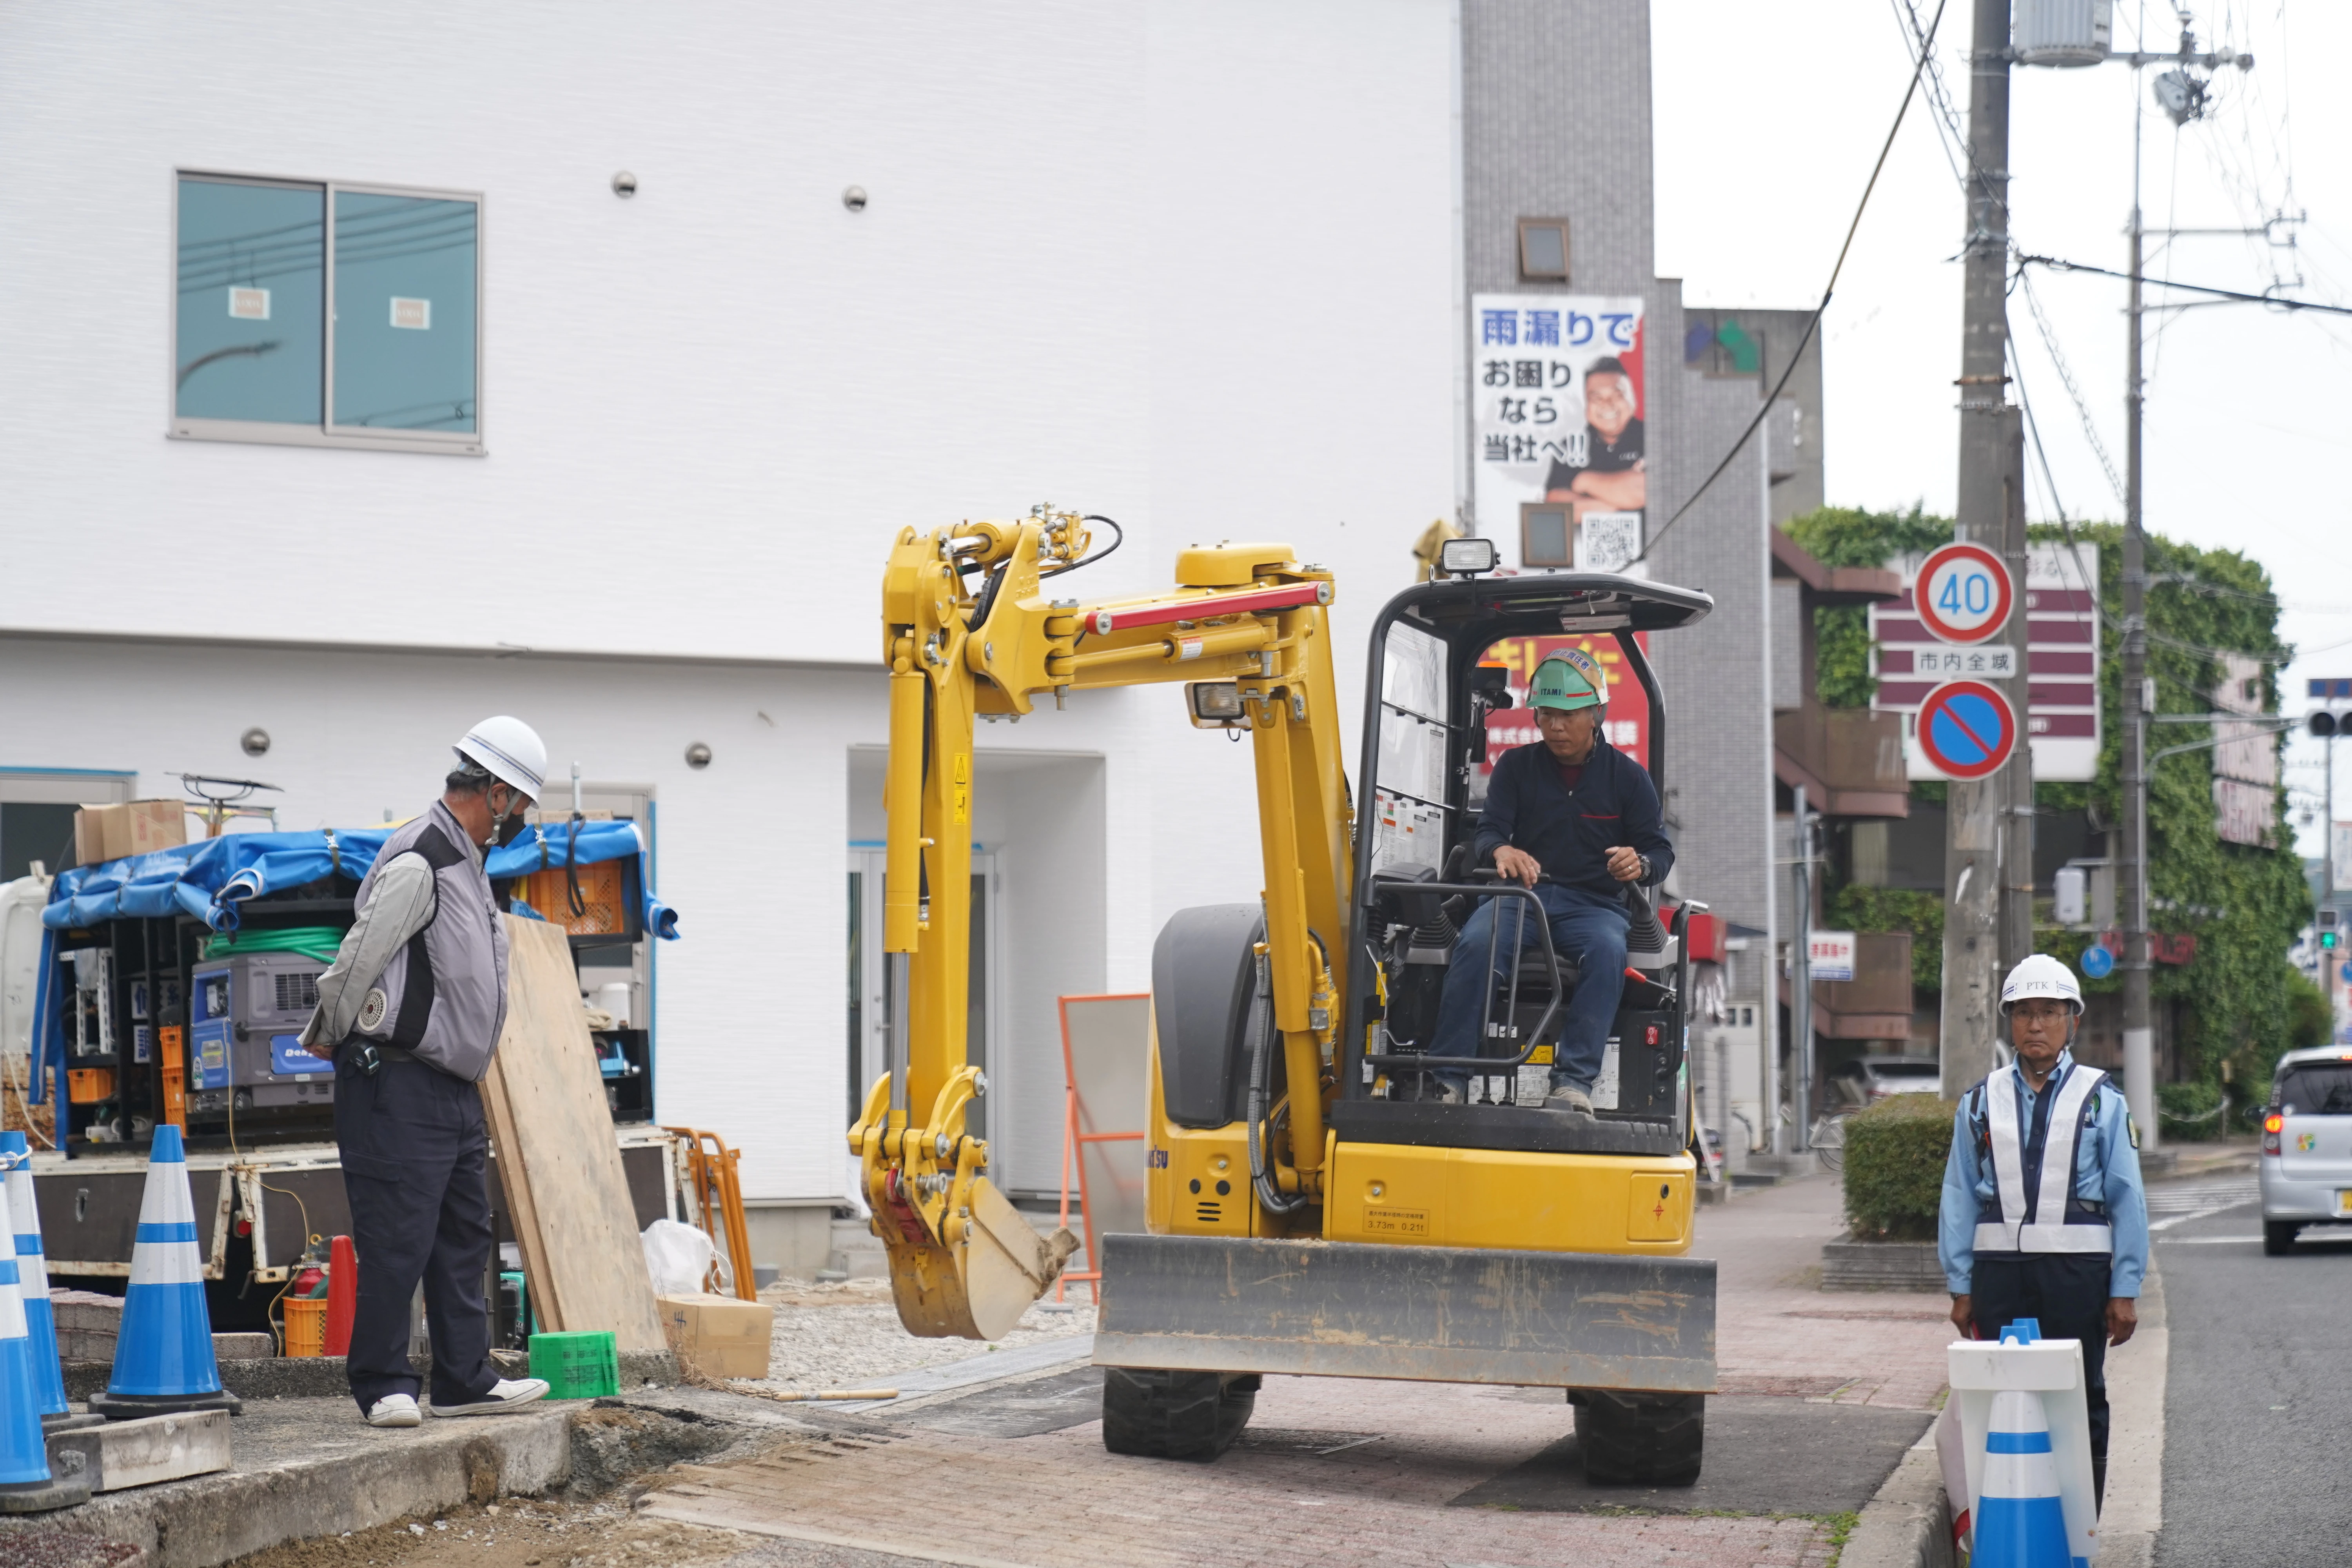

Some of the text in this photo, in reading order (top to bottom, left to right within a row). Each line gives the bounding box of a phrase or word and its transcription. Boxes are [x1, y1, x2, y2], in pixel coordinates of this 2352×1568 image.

[1482, 309, 1634, 347] 雨漏りで
[1484, 360, 1571, 388] お困り
[1499, 396, 1557, 424] なら
[1938, 573, 1989, 615] 40
[1920, 652, 2009, 671] 市内全域
[2027, 982, 2049, 990] PTK
[1368, 1220, 1424, 1232] 3.73m 0.21t
